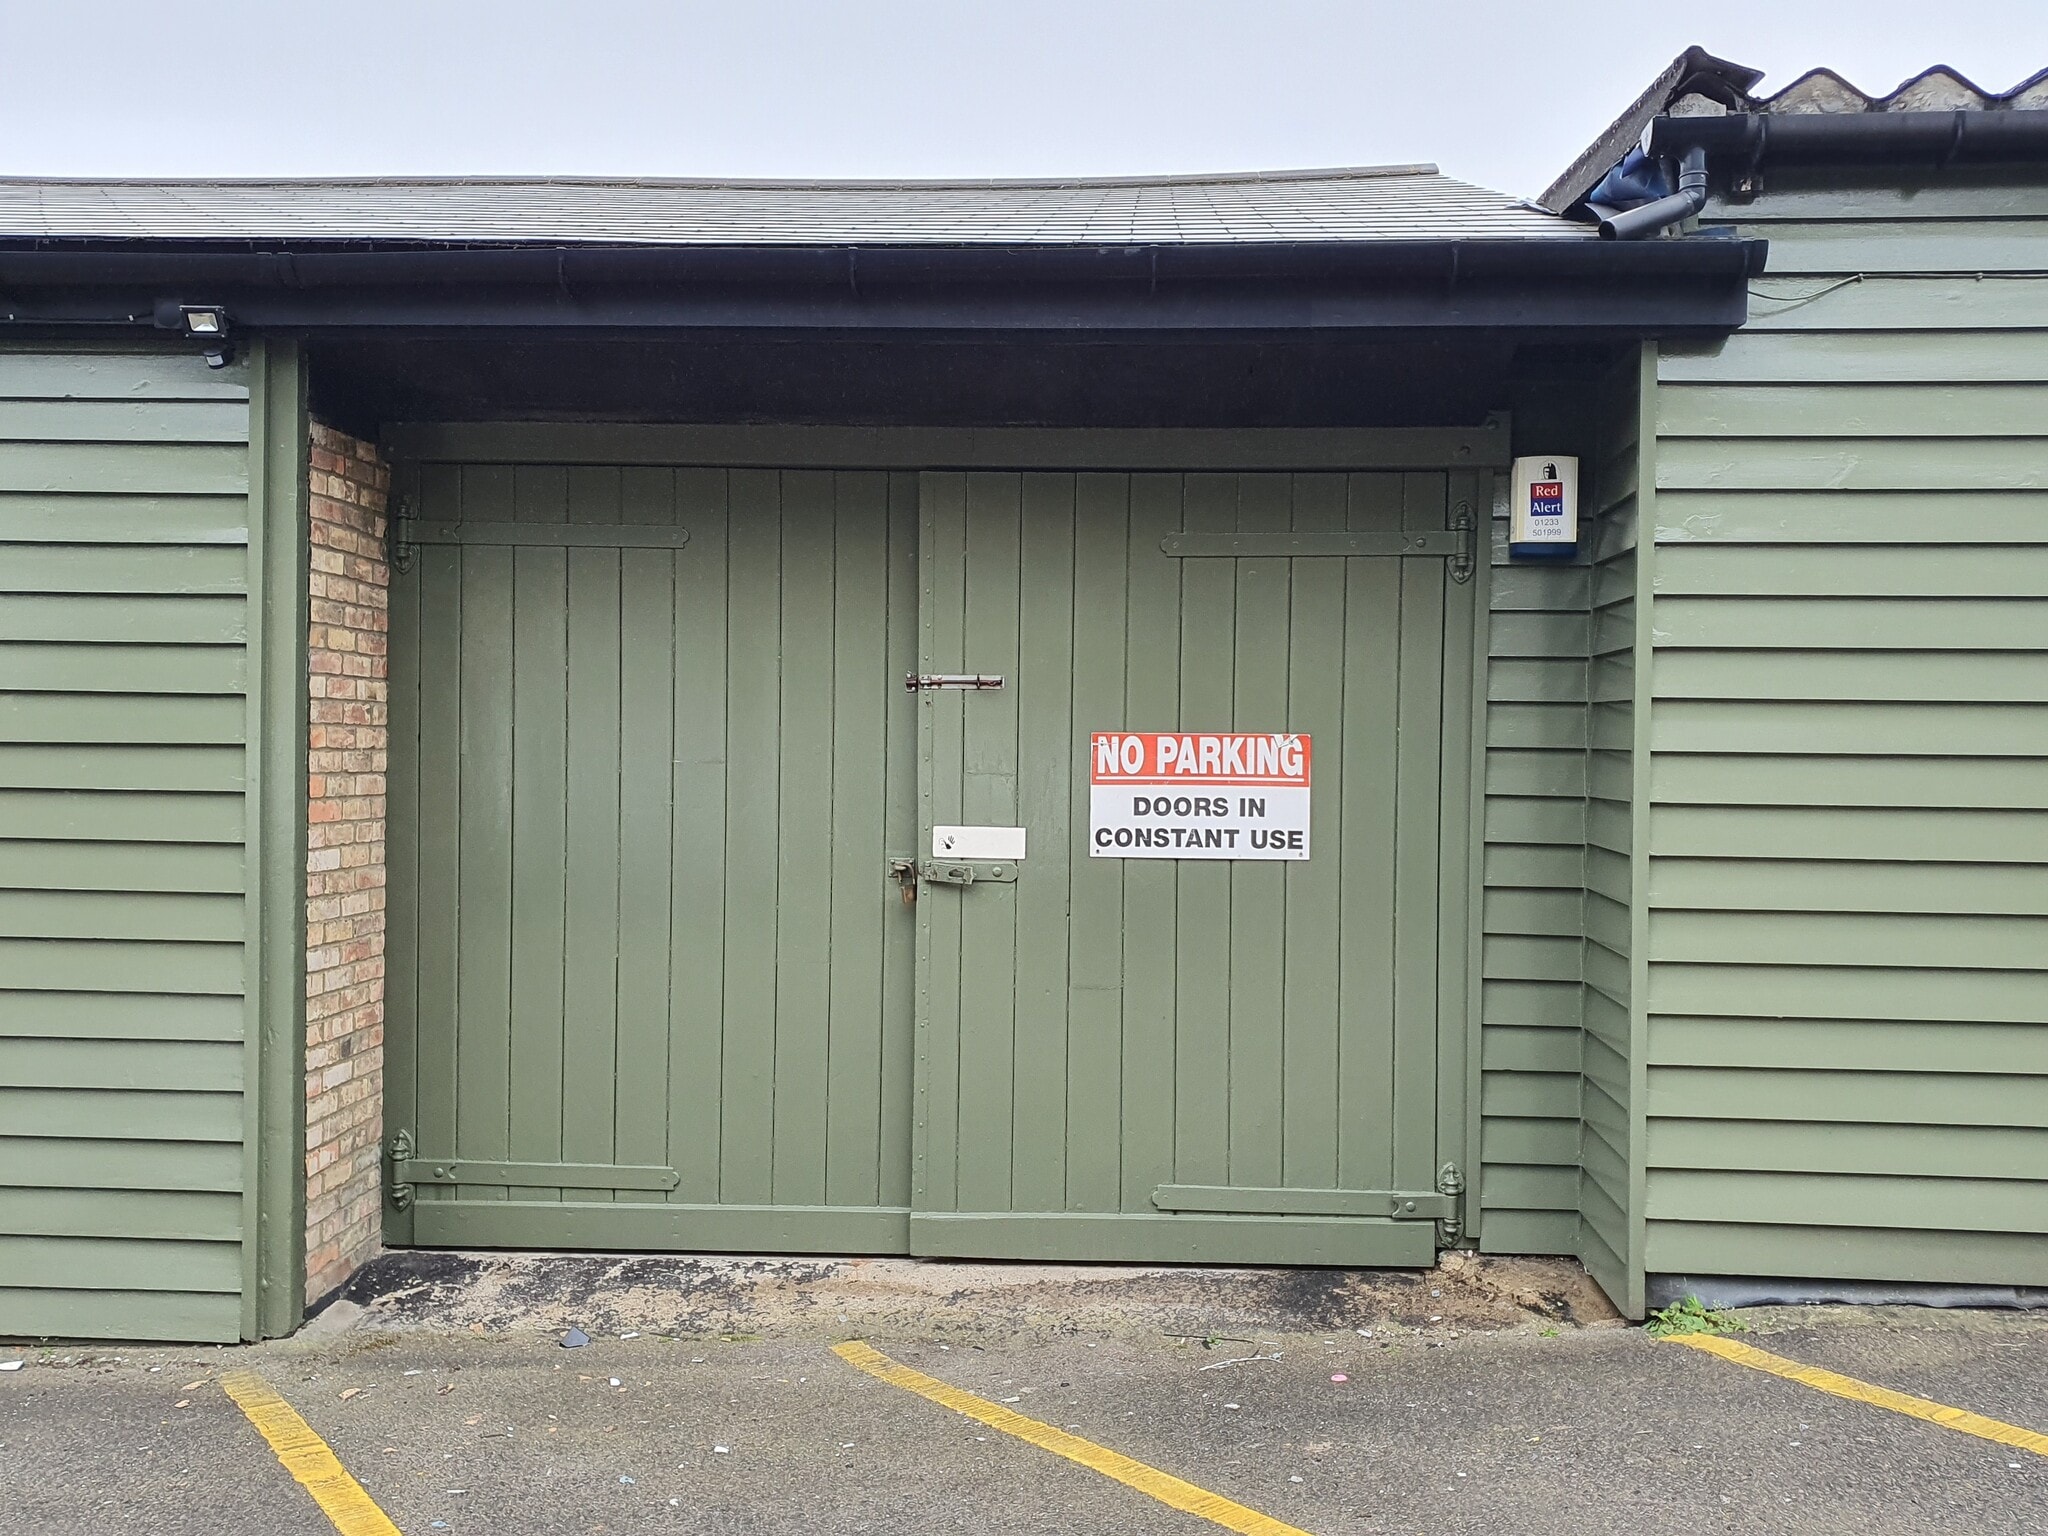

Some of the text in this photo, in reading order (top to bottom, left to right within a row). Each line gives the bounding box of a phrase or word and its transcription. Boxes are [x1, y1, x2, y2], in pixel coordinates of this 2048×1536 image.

[1536, 485, 1558, 497] Red
[1532, 502, 1561, 513] Alert
[1532, 529, 1562, 537] 501999
[1097, 735, 1304, 776] NO PARKING
[1133, 796, 1266, 818] DOORS IN
[1095, 827, 1304, 850] CONSTANT USE
